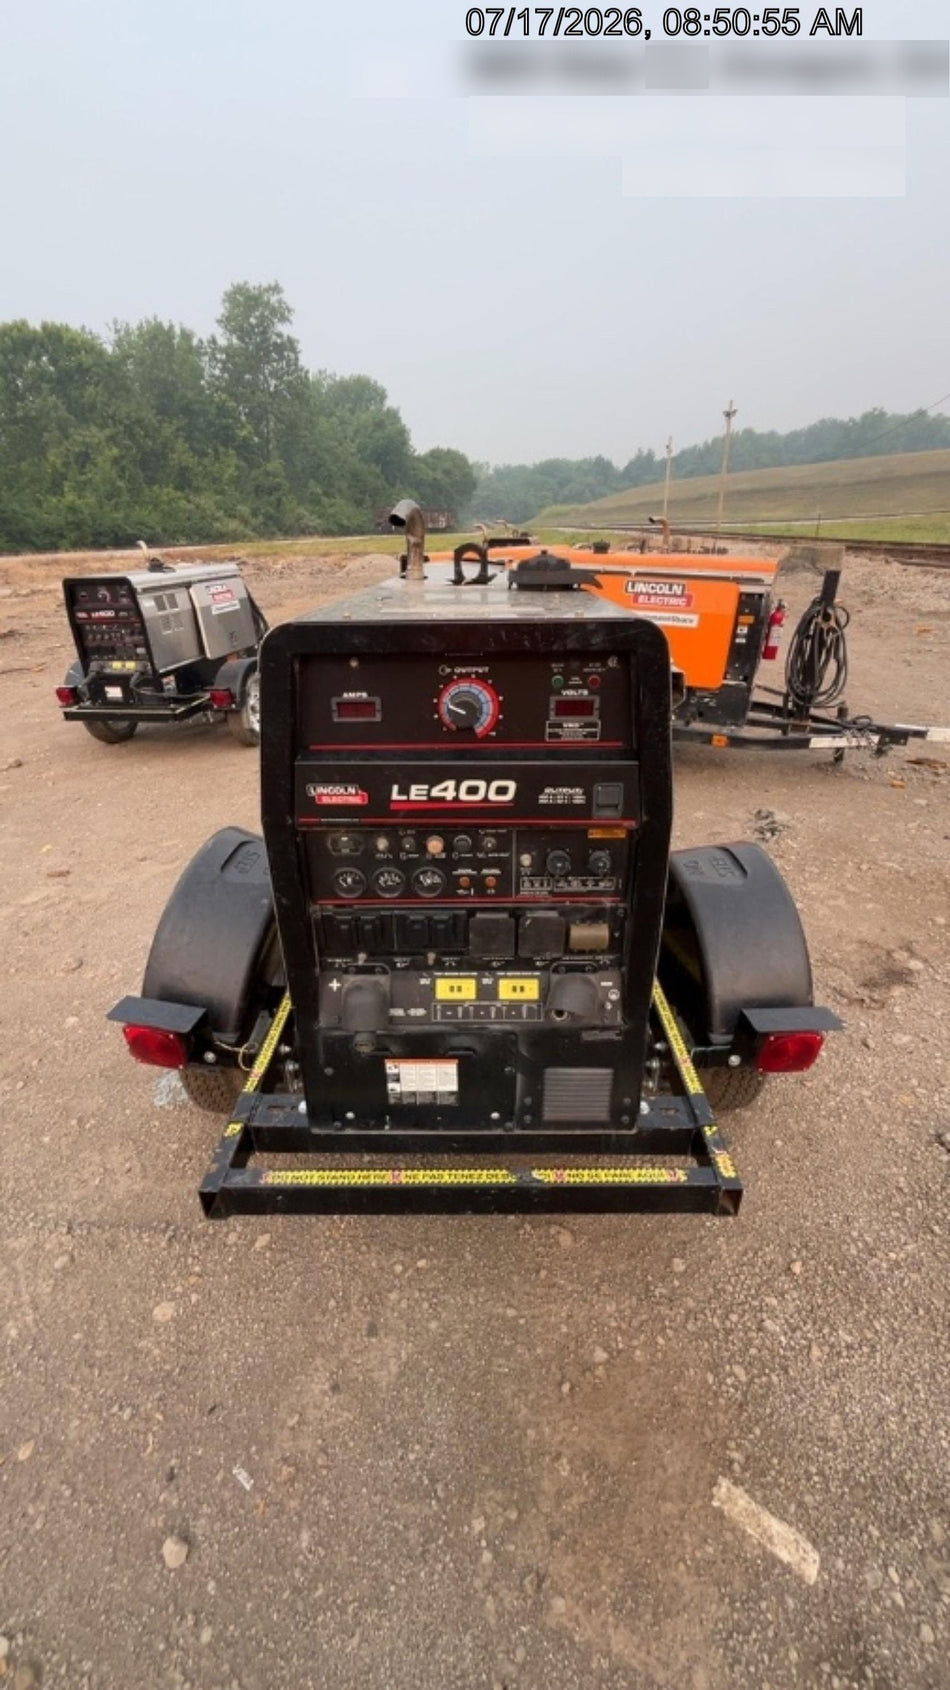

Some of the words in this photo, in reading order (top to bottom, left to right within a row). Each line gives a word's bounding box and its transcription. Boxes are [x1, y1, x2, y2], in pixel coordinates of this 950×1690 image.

[627, 581, 683, 595] LINCOLN
[637, 594, 688, 606] ELECTRIC
[342, 691, 368, 699] AMPS
[561, 689, 589, 697] VOLTS
[310, 785, 356, 795] LINCOLN
[390, 779, 517, 802] LE400
[317, 1173, 354, 1181] STAND
[358, 1173, 387, 1181] HERE
[405, 1172, 420, 1180] NE
[422, 1172, 444, 1180] PAS
[448, 1172, 483, 1180] TENEZ
